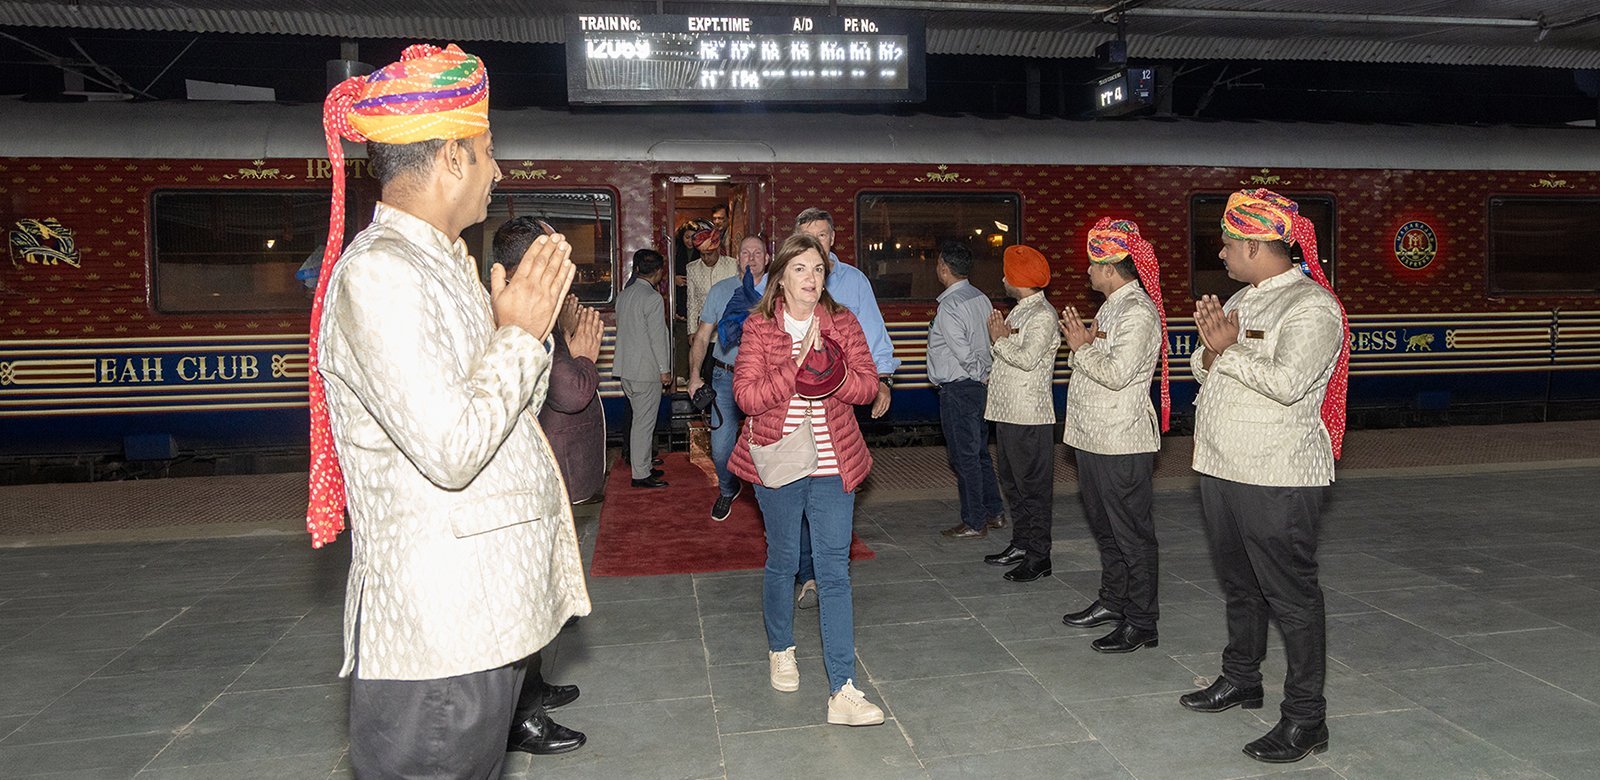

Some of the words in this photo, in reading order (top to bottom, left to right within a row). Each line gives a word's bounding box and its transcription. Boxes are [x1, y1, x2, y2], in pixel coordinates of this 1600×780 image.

[579, 16, 618, 31] TRAIN
[793, 18, 813, 31] A/D
[1142, 69, 1151, 80] 12
[176, 355, 260, 381] CLUB
